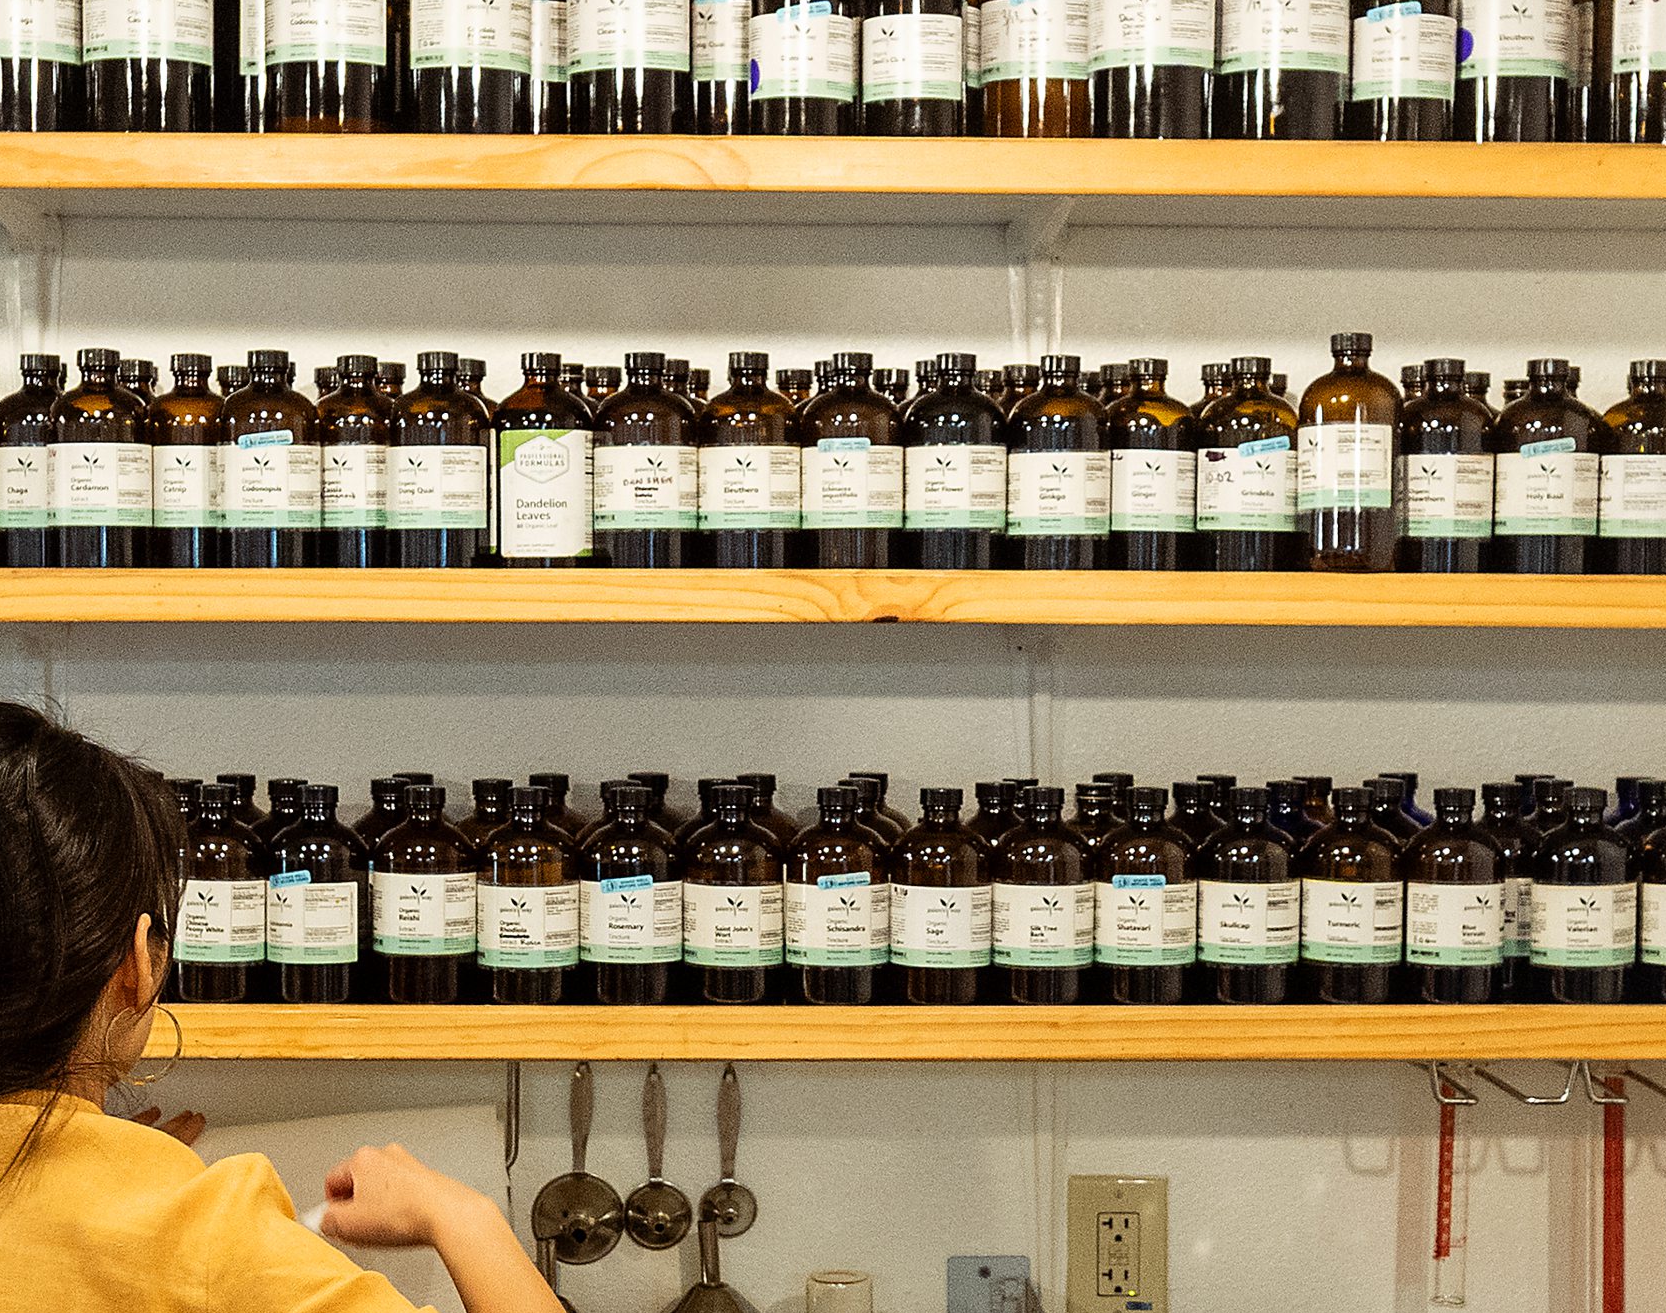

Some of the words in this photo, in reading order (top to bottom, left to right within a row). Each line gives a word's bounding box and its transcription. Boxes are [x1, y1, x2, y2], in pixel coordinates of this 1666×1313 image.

[163, 486, 187, 494] Catnip
[517, 499, 567, 508] Dandelion
[517, 511, 551, 520] Leaves
[186, 926, 203, 934] Peony
[608, 923, 644, 931] Rosemary
[1220, 921, 1250, 931] Skullcap
[927, 928, 944, 936] Sage
